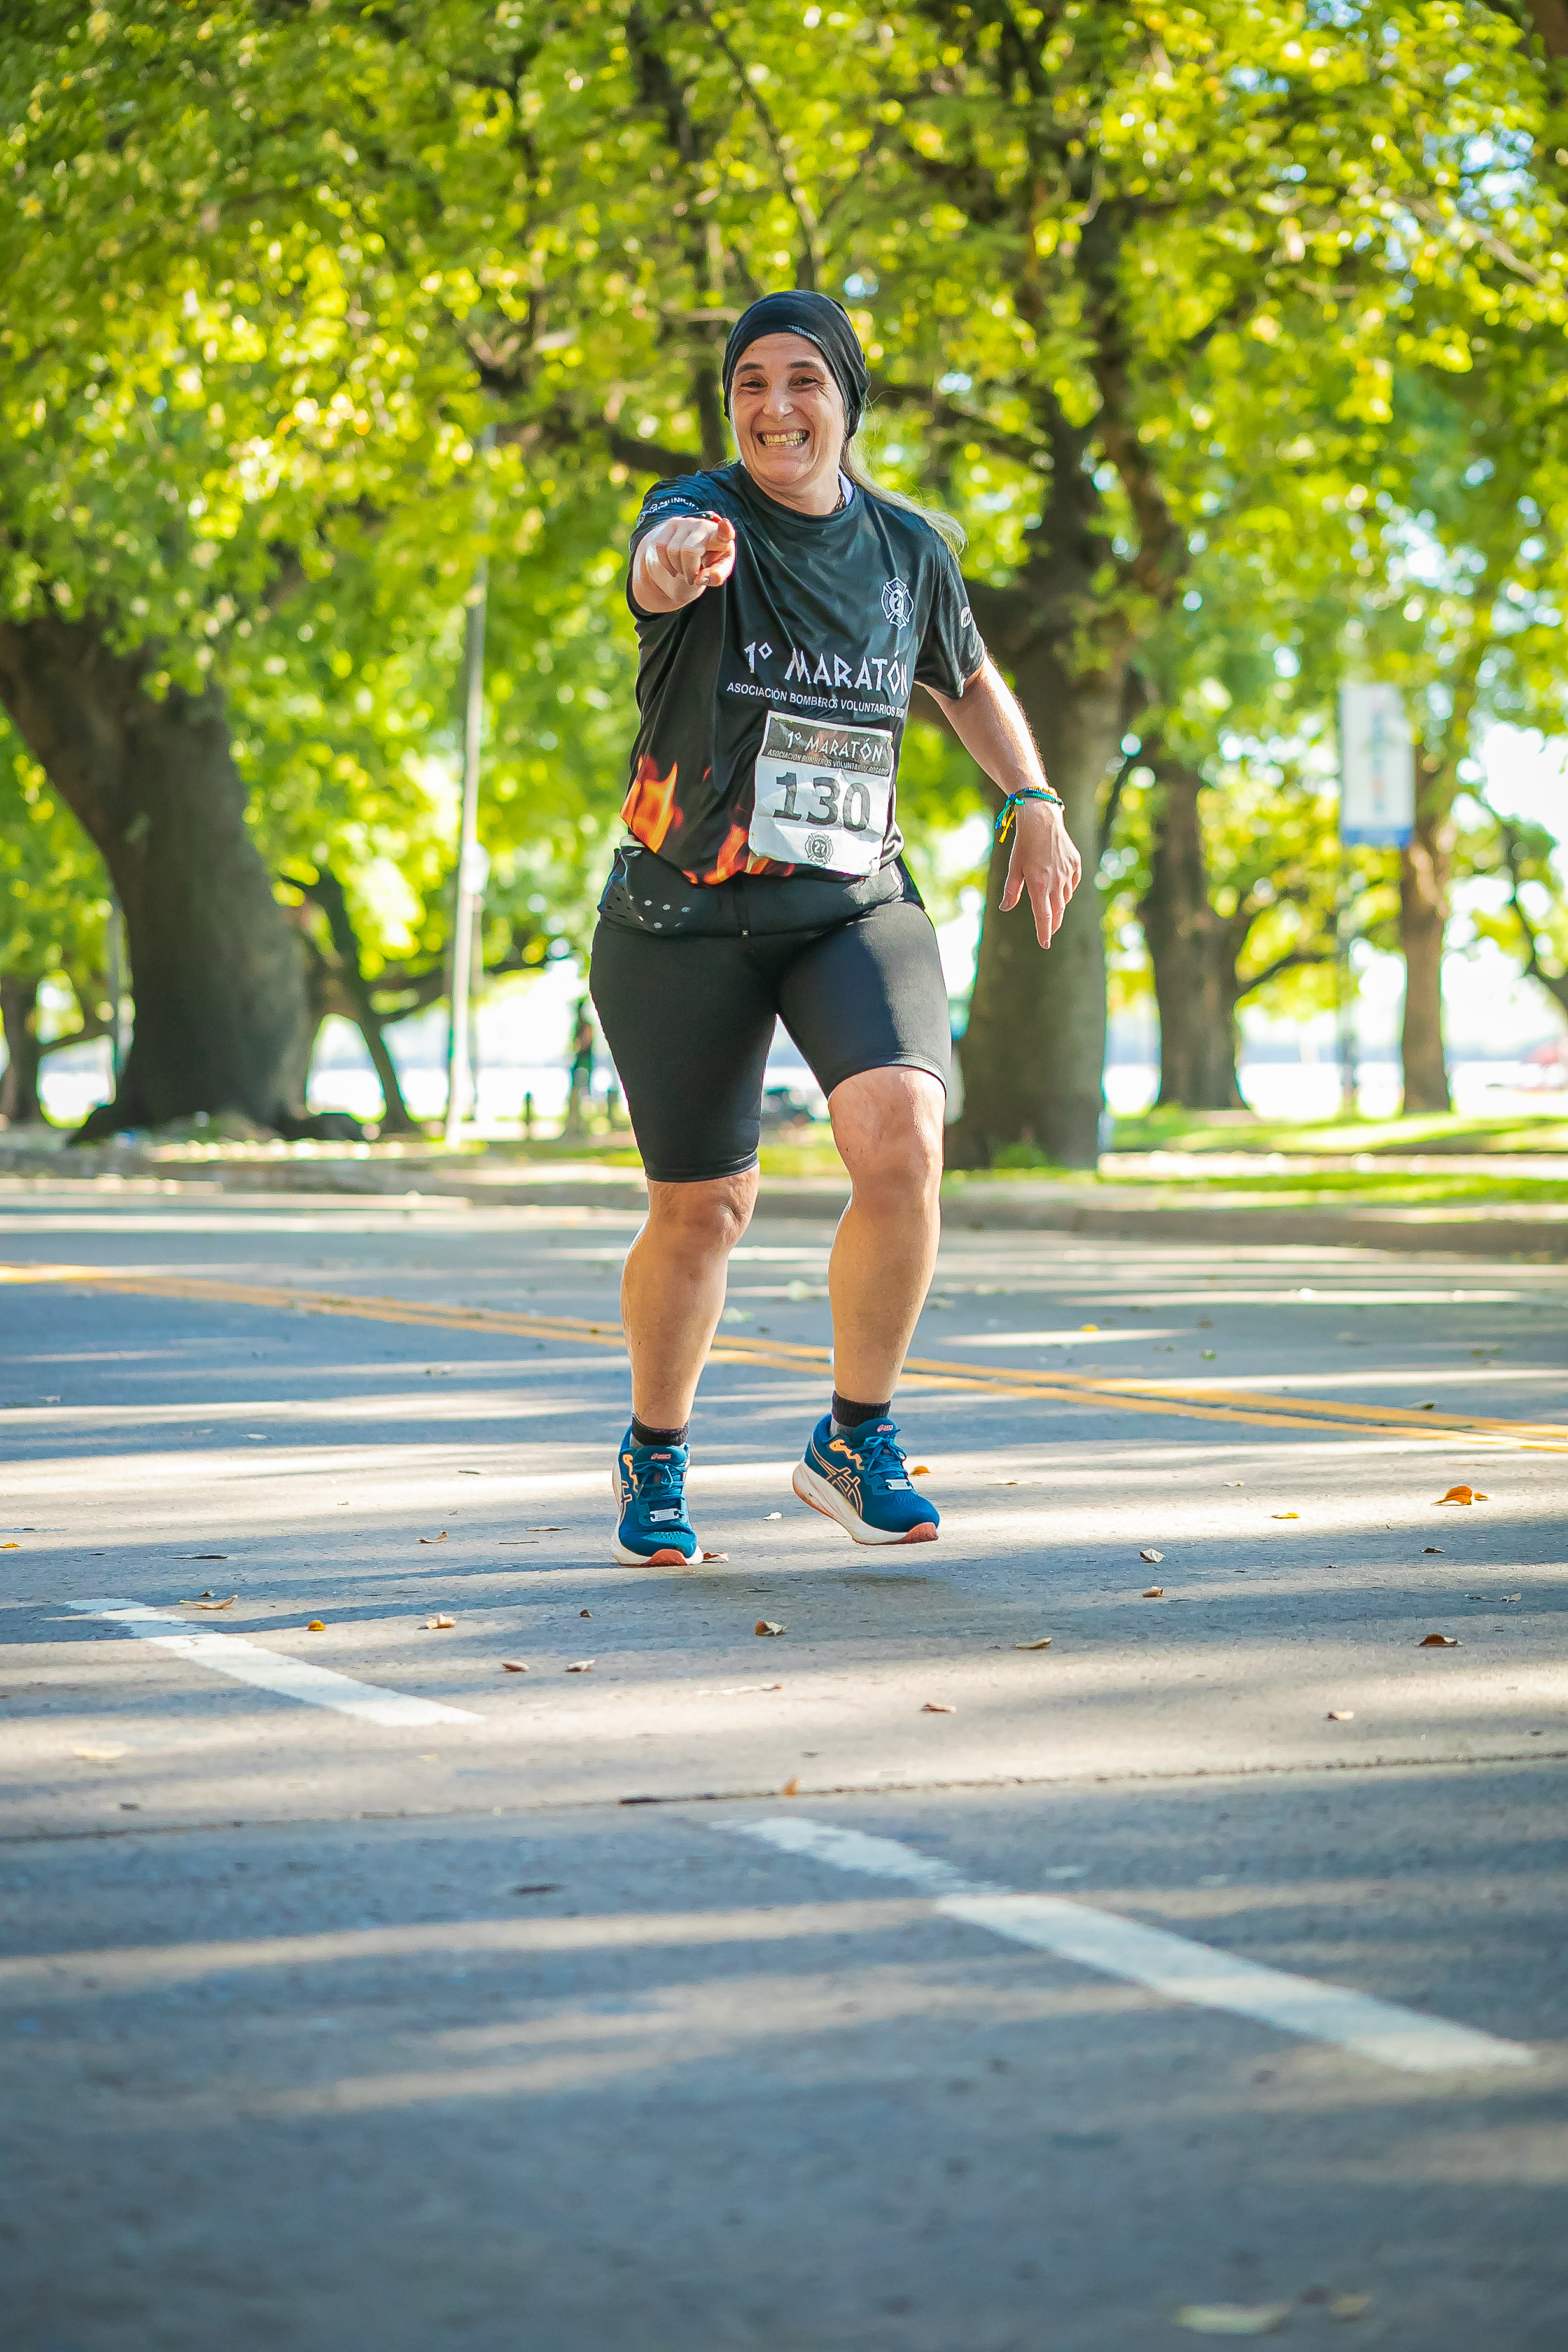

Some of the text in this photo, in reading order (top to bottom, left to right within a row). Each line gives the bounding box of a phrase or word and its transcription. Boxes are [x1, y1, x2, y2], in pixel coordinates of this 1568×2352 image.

[785, 647, 909, 696] MARATÓN
[727, 682, 788, 701] ASOCIACIÓN
[789, 692, 838, 709] BOMBEROS
[841, 699, 895, 716] VOLUNTARIOS
[766, 749, 802, 762] ASOCIACIÓN
[801, 755, 832, 767] BOMBEROS
[804, 735, 883, 762] MARATÓN
[773, 771, 871, 832] 130
[814, 840, 826, 855] 27
